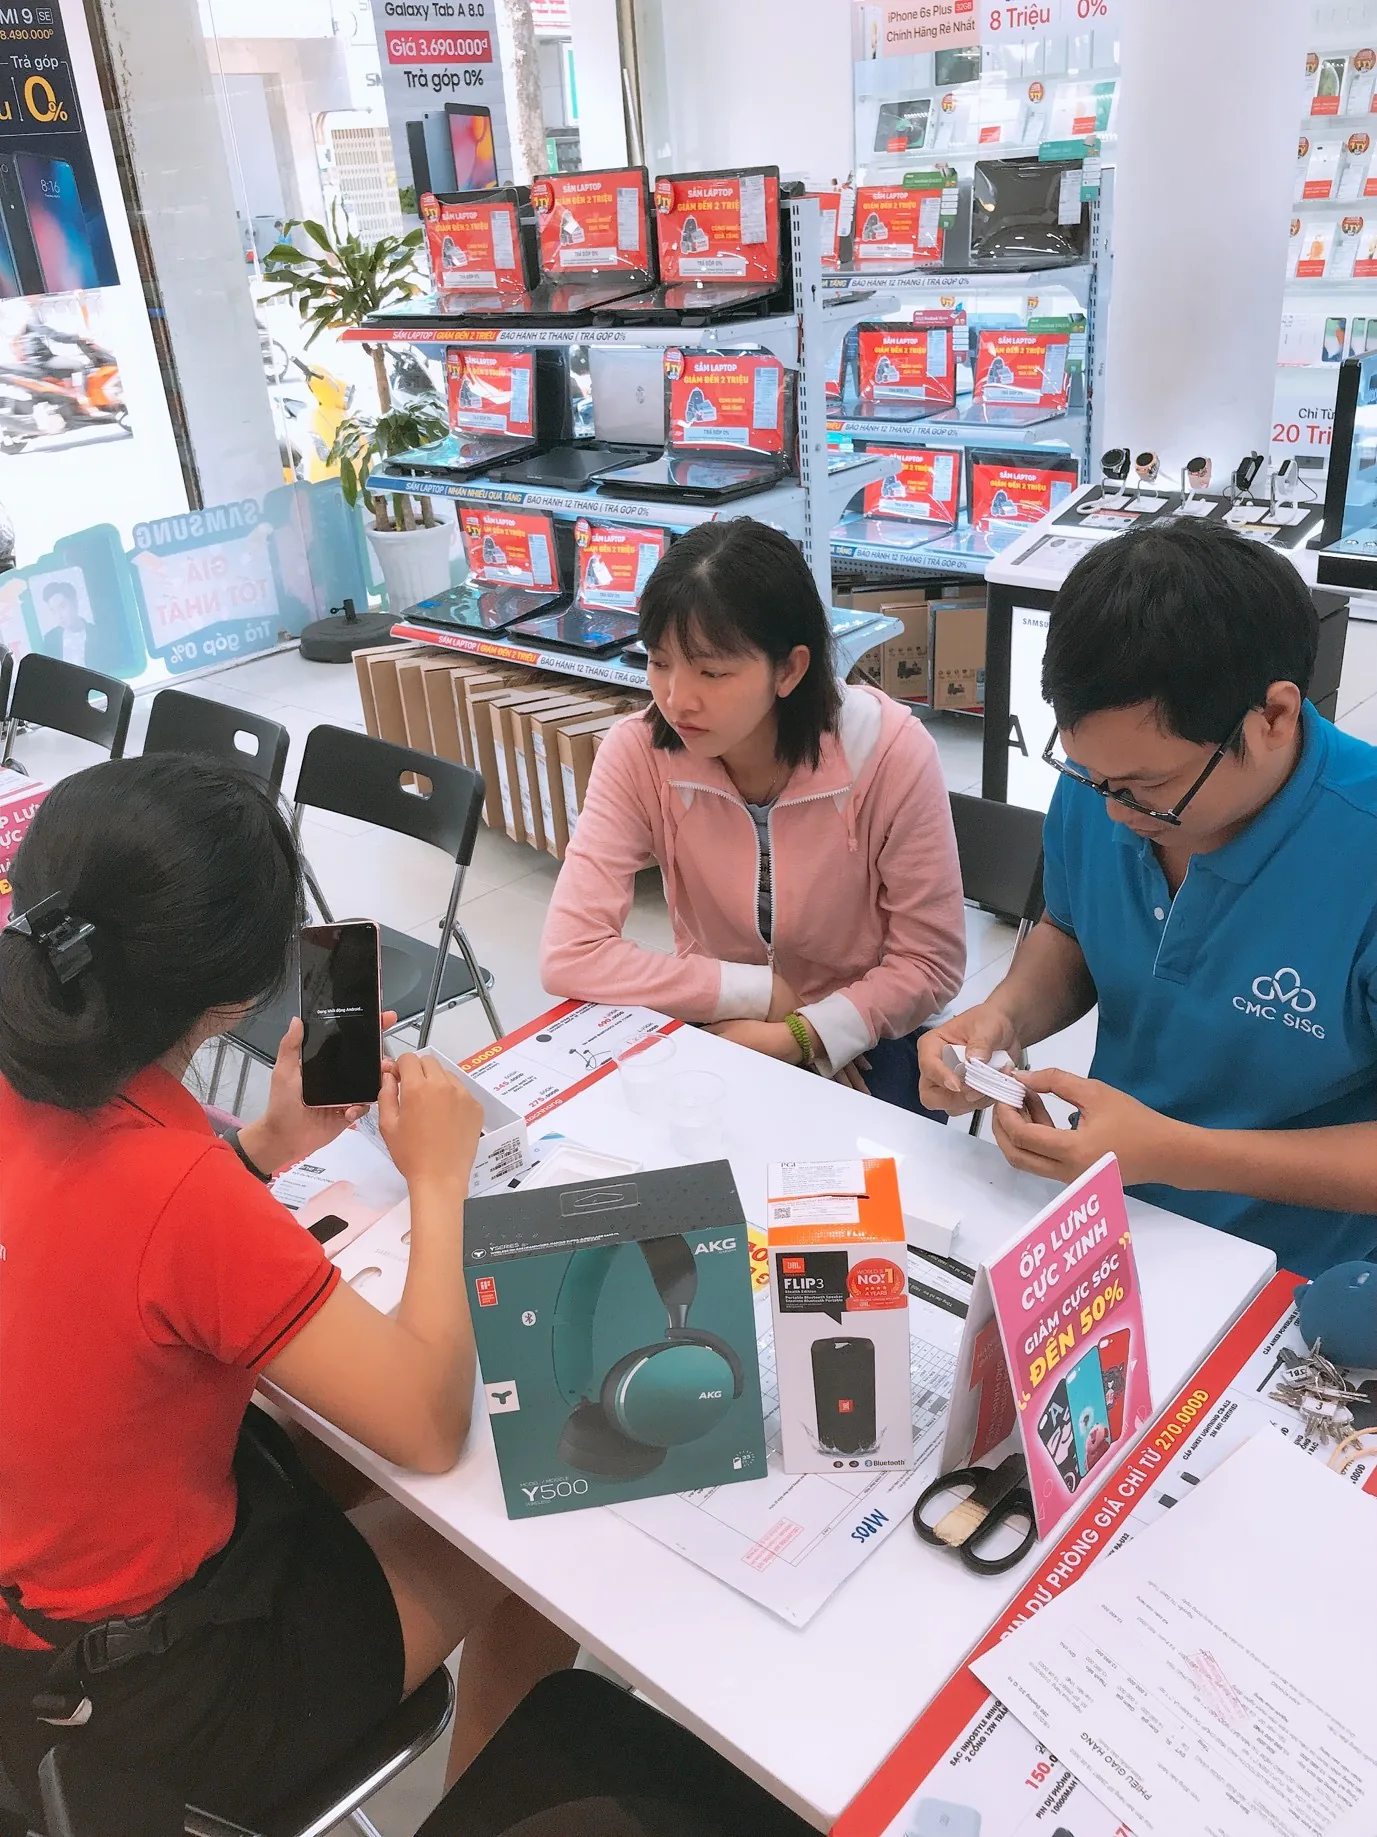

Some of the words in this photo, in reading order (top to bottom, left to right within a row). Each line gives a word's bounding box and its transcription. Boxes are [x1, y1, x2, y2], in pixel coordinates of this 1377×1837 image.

[22, 8, 33, 23] 9
[39, 11, 51, 21] SE
[385, 2, 429, 21] Galaxy
[434, 3, 454, 17] Tab
[458, 4, 466, 17] A
[469, 4, 485, 17] 8.0
[888, 10, 918, 23] iPhone
[920, 7, 931, 19] 6s
[933, 5, 952, 17] Plus
[990, 12, 1001, 31] 8
[1007, 7, 1050, 31] Triệu
[1077, 0, 1107, 19] 0%
[886, 26, 912, 42] Chính
[914, 24, 937, 41] Hãng
[939, 20, 951, 35] Rẻ
[953, 17, 976, 33] Nhất
[390, 38, 416, 57] Giá
[10, 55, 31, 69] Trả
[35, 56, 58, 70] góp
[404, 69, 428, 88] Trả
[432, 69, 460, 92] góp
[464, 70, 484, 86] 0%
[24, 76, 68, 122] 0%
[40, 179, 60, 193] 8:16
[694, 361, 710, 371] SẮM
[711, 363, 737, 371] LAPTOP
[1298, 407, 1316, 421] Chỉ
[1272, 424, 1300, 443] 20
[1232, 996, 1277, 1020] CMC
[1282, 1013, 1326, 1040] SISG
[695, 1237, 737, 1256] AKG
[1019, 1241, 1046, 1280] ỐP
[1050, 1194, 1101, 1250] LƯNG
[787, 1261, 802, 1270] JBL
[1021, 1262, 1060, 1310] CỰC
[1063, 1217, 1108, 1272] XINH
[1024, 1311, 1060, 1355] GIẢM
[1062, 1281, 1090, 1317] CỰC
[1091, 1254, 1121, 1288] SỐC
[1029, 1323, 1076, 1388] ĐẾN
[1080, 1278, 1124, 1336] 50%
[699, 1390, 722, 1399] AKG
[873, 1459, 905, 1467] Bluetooth
[521, 1478, 588, 1502] Y500
[1042, 1522, 1101, 1589] PHÒNG
[1089, 1492, 1124, 1529] GIÁ
[1113, 1463, 1147, 1499] CHỈ
[1136, 1444, 1162, 1471] TỪ
[1154, 1386, 1210, 1452] 270.000Đ
[851, 1508, 889, 1543] MPOS
[949, 1750, 964, 1767] SẠC
[960, 1718, 988, 1751] INNOSTYLE
[967, 1734, 987, 1756] CỔNG
[983, 1721, 997, 1736] 12W
[1078, 1731, 1106, 1757] HÀNG
[1103, 1754, 1126, 1776] GIAO
[1035, 1805, 1047, 1819] PIN
[1043, 1795, 1055, 1807] DỰ
[1049, 1770, 1071, 1796] PHÒNG
[1126, 1772, 1152, 1801] PHIẾU
